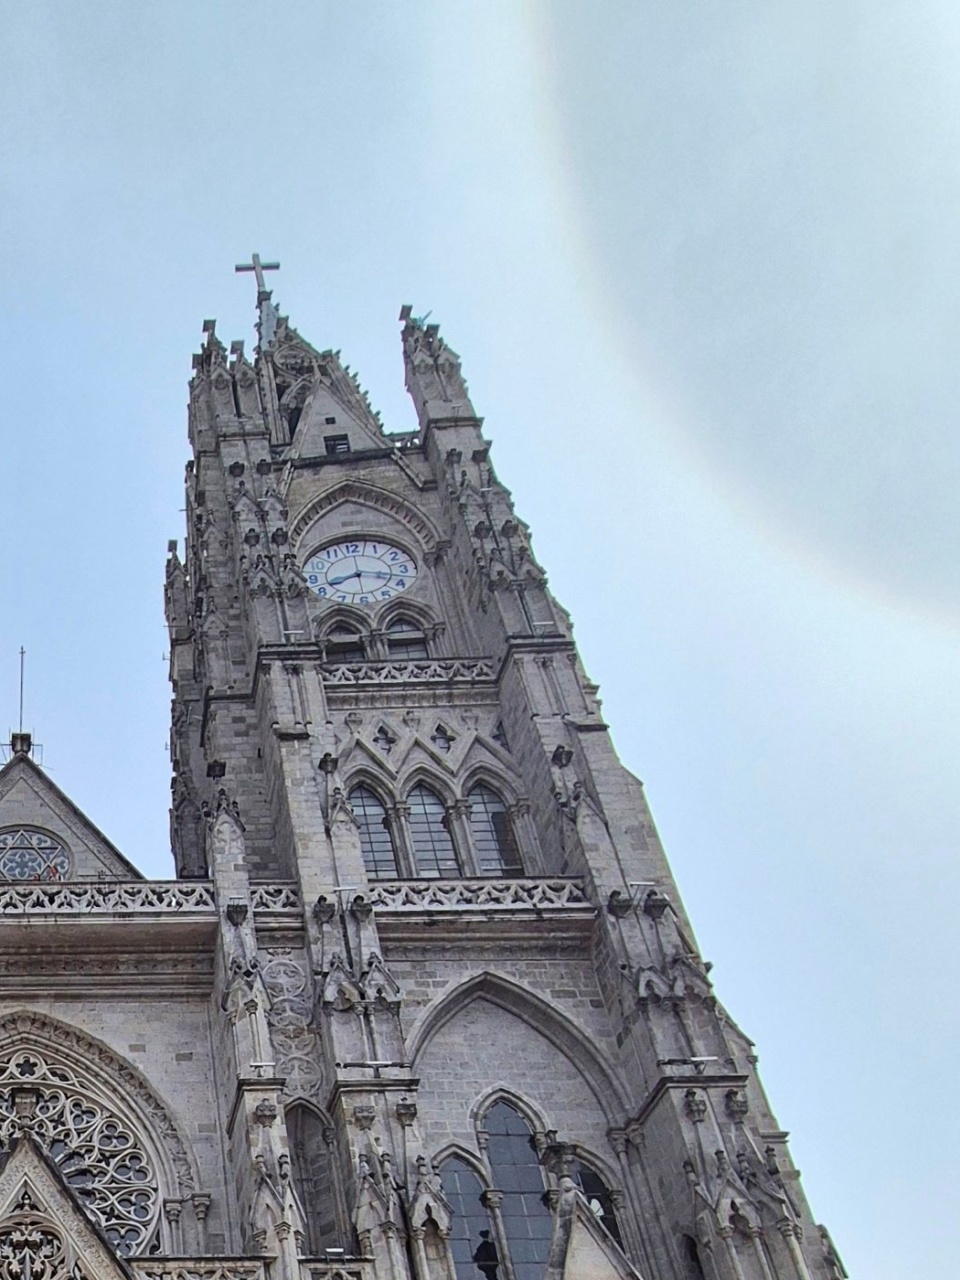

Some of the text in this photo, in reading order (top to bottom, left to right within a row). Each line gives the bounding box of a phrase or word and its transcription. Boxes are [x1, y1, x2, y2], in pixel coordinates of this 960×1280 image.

[327, 549, 337, 558] 11
[346, 544, 360, 554] 12
[389, 552, 399, 561] 2
[311, 561, 324, 570] 10
[399, 565, 408, 573] 3
[309, 575, 318, 584] 9
[396, 579, 405, 588] 4
[318, 587, 326, 596] 8
[381, 591, 391, 599] 5
